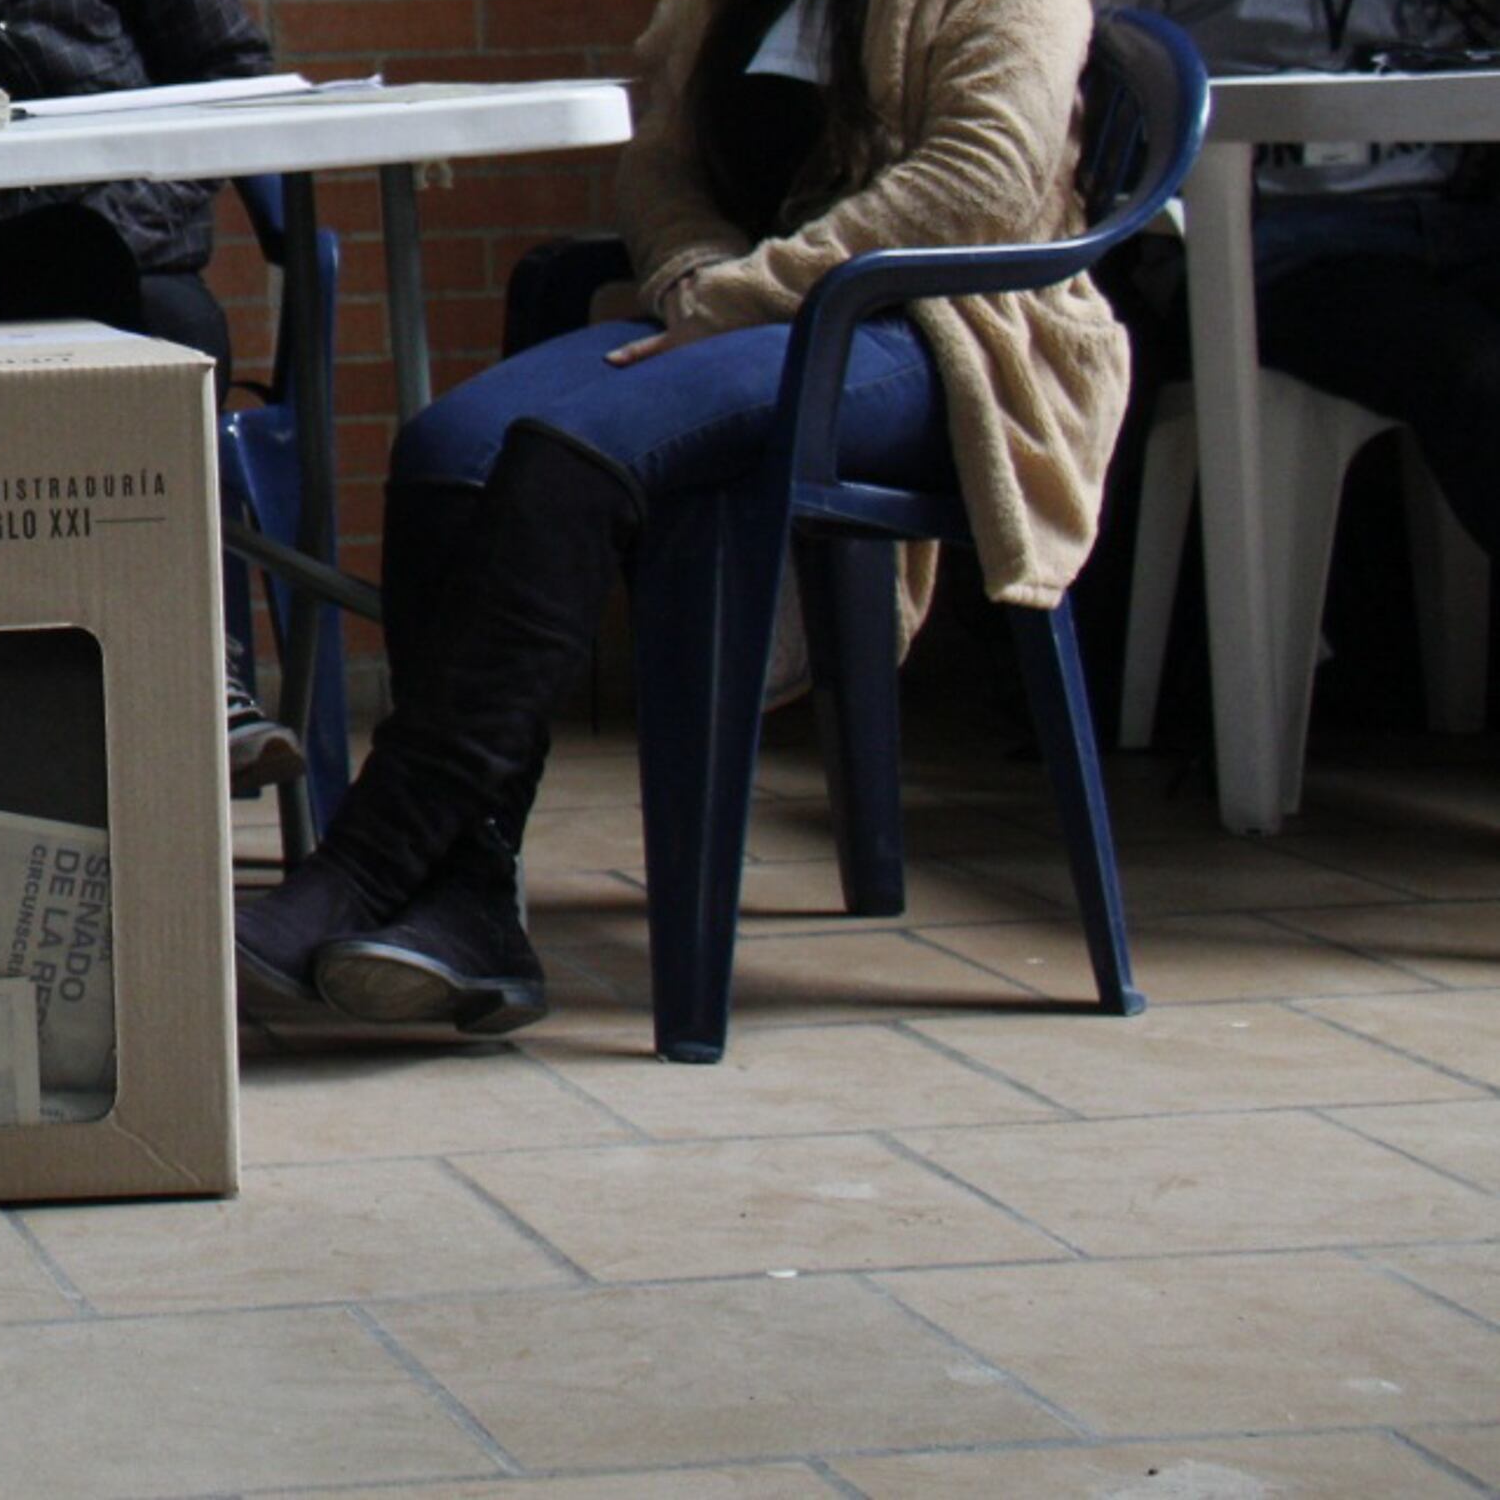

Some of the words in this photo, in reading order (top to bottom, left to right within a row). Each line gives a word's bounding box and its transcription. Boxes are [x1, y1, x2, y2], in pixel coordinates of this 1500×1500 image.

[49, 505, 91, 538] XXI
[49, 848, 80, 897] DE
[38, 907, 70, 949] LA
[59, 853, 111, 1004] SENADO
